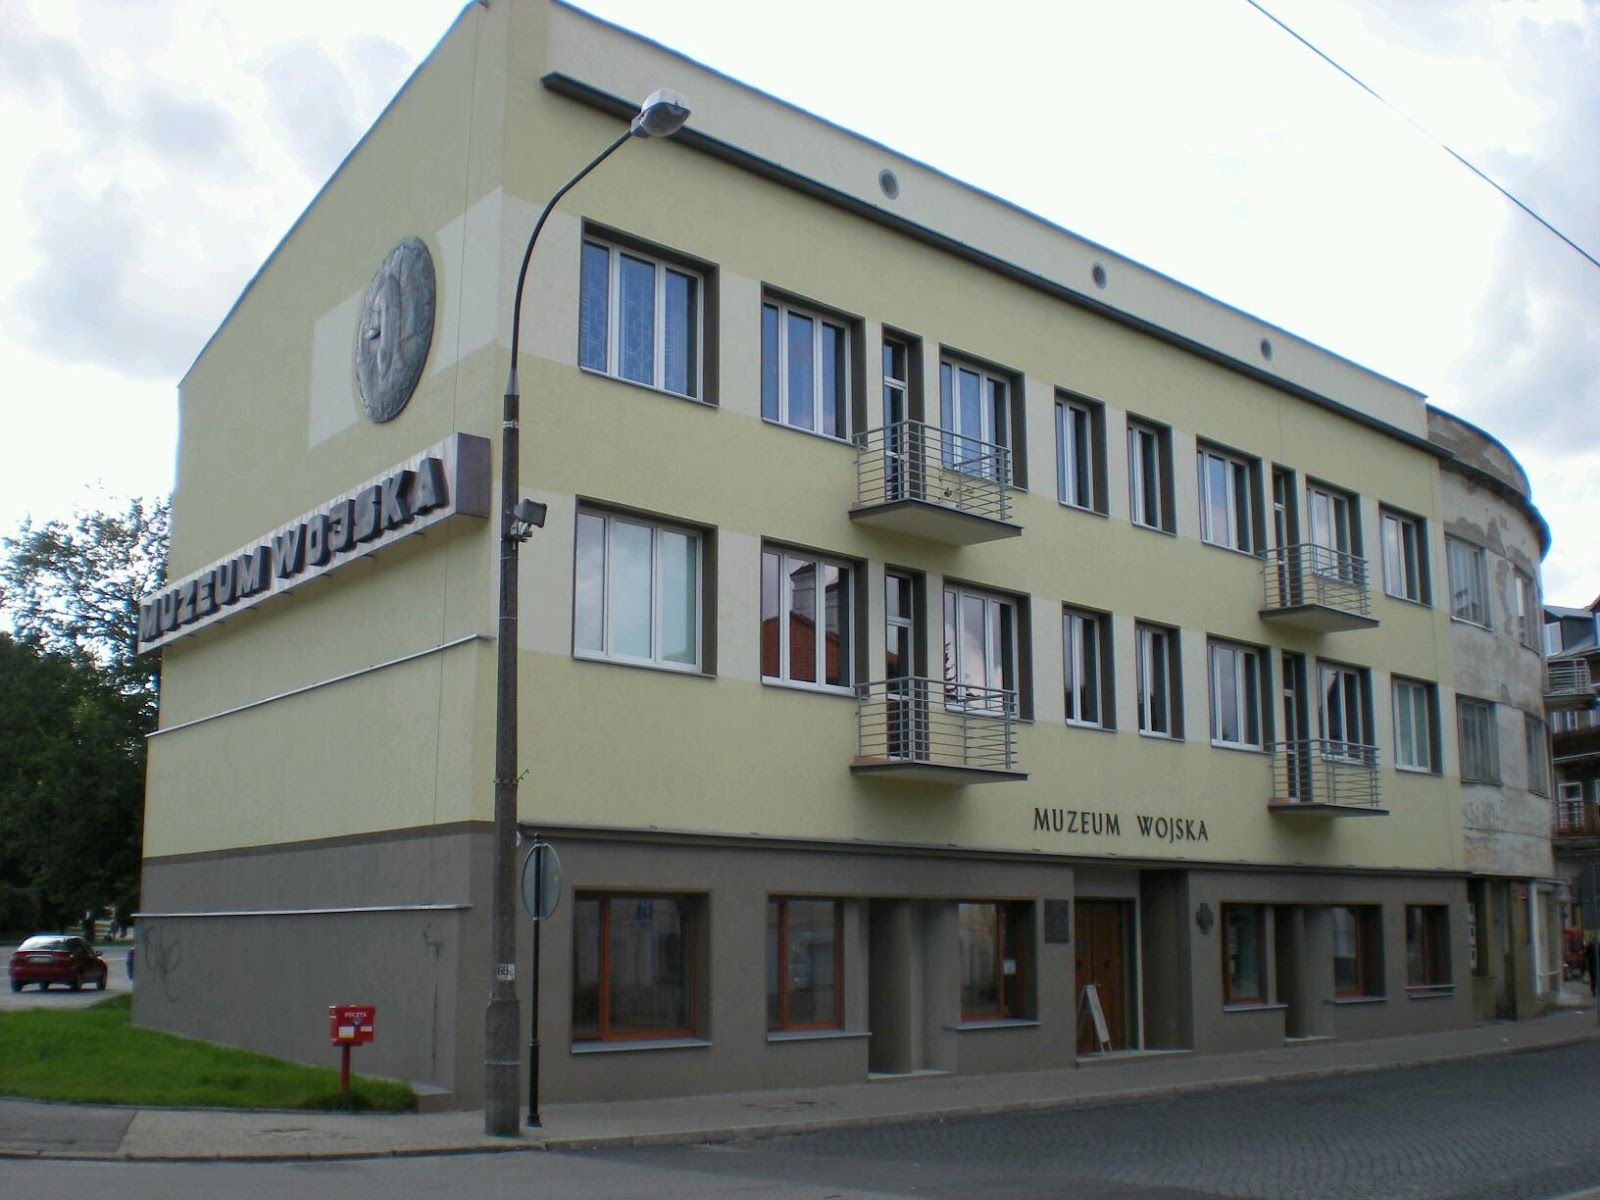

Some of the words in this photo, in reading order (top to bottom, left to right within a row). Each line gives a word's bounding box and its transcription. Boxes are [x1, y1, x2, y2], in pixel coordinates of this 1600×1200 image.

[138, 545, 272, 643] MUZEUM
[271, 457, 450, 579] WOJSKA
[1033, 807, 1121, 836] MUZEUM
[1137, 815, 1209, 844] WOJSKA
